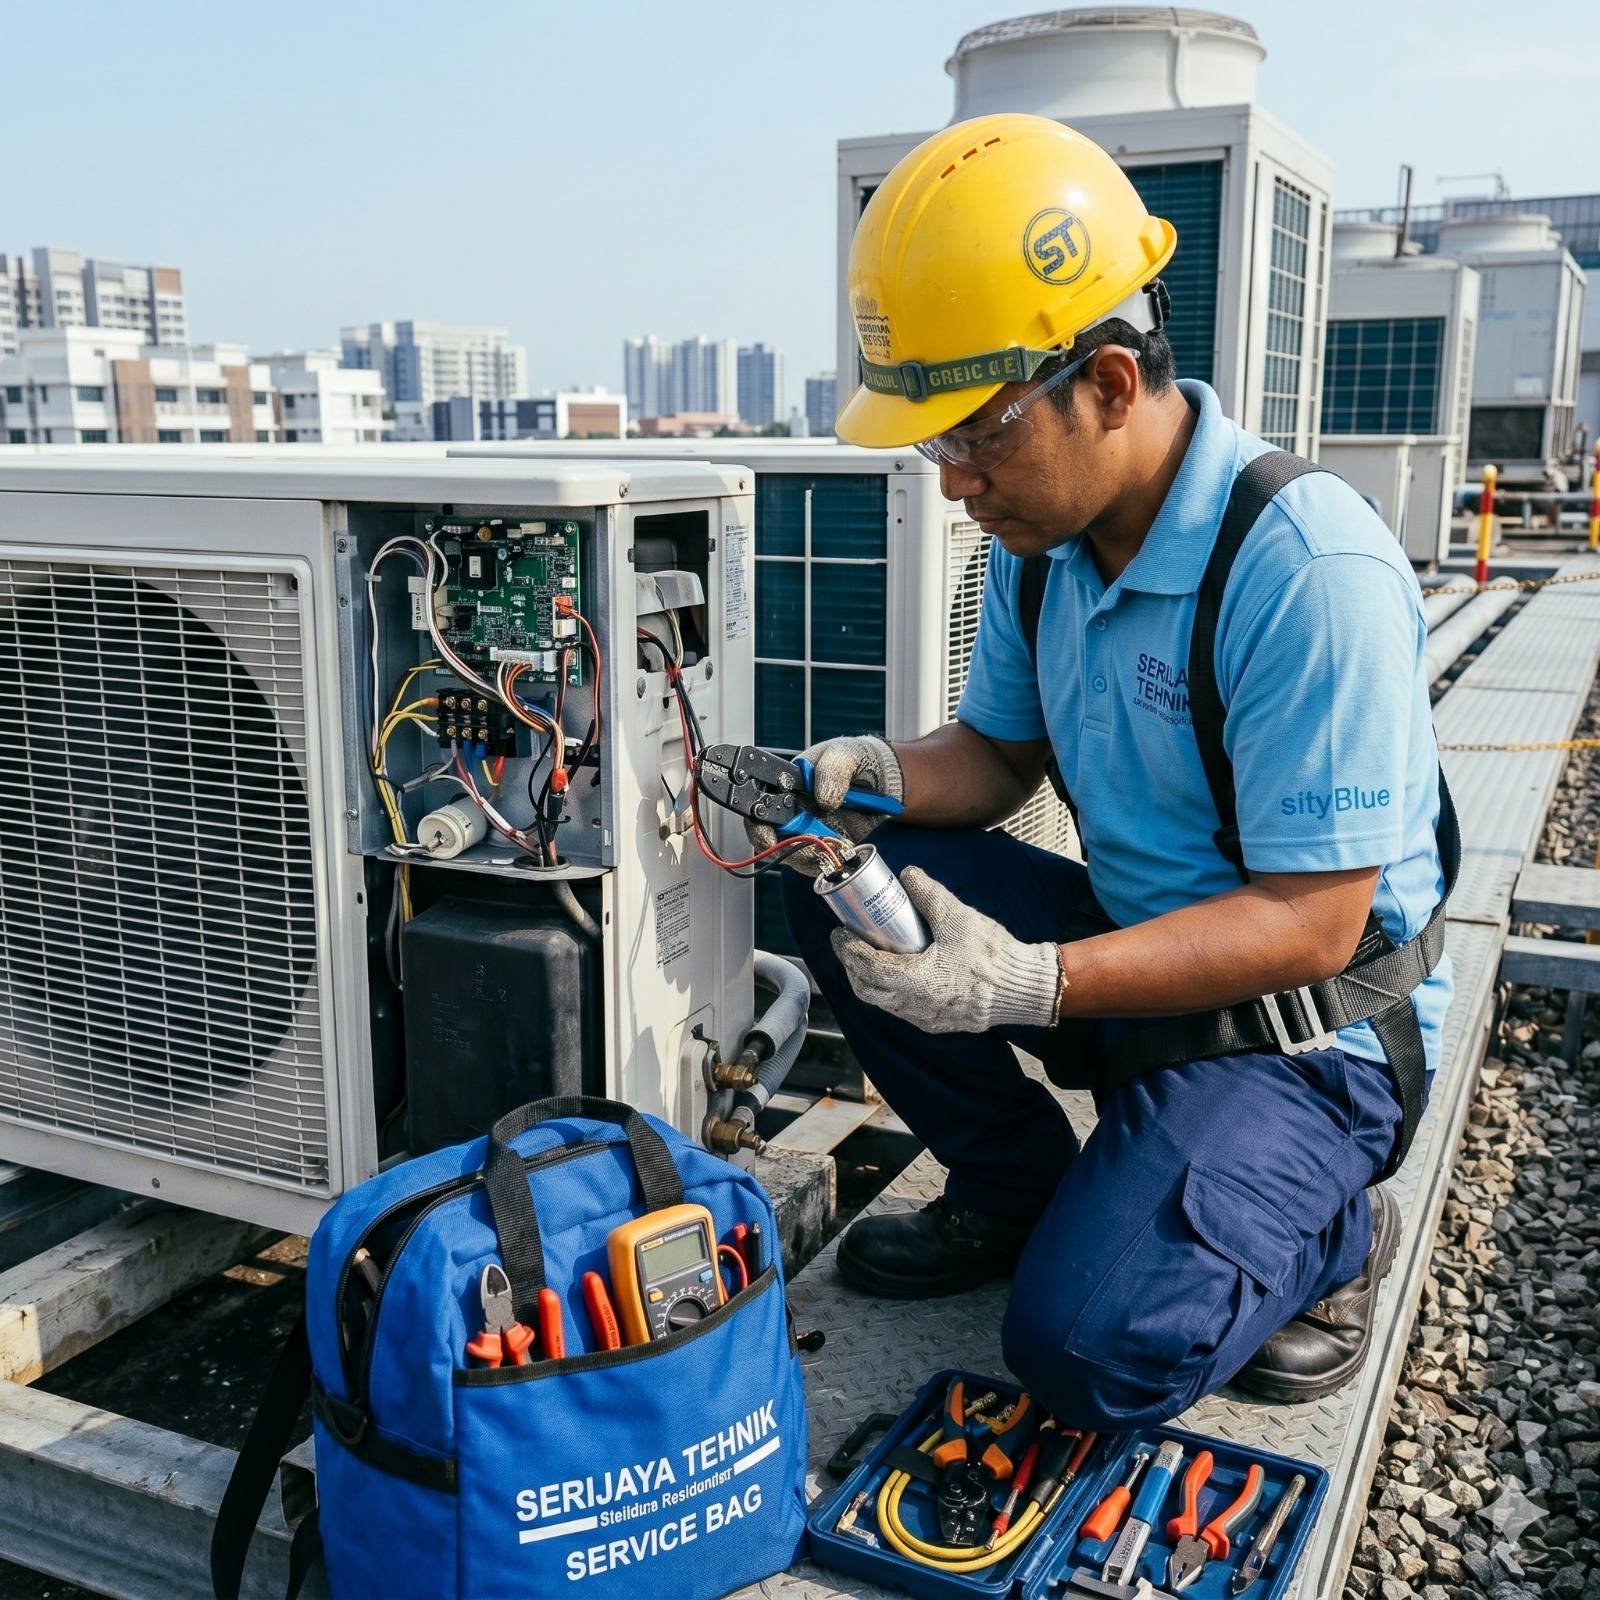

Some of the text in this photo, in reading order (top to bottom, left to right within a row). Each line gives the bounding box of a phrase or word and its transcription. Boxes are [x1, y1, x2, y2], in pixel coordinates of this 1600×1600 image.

[1033, 216, 1079, 276] ST
[1280, 786, 1390, 819] sityBlue
[516, 1399, 777, 1522] SERIJAYA TEHNIK
[566, 1484, 762, 1581] SERVICE BAG
